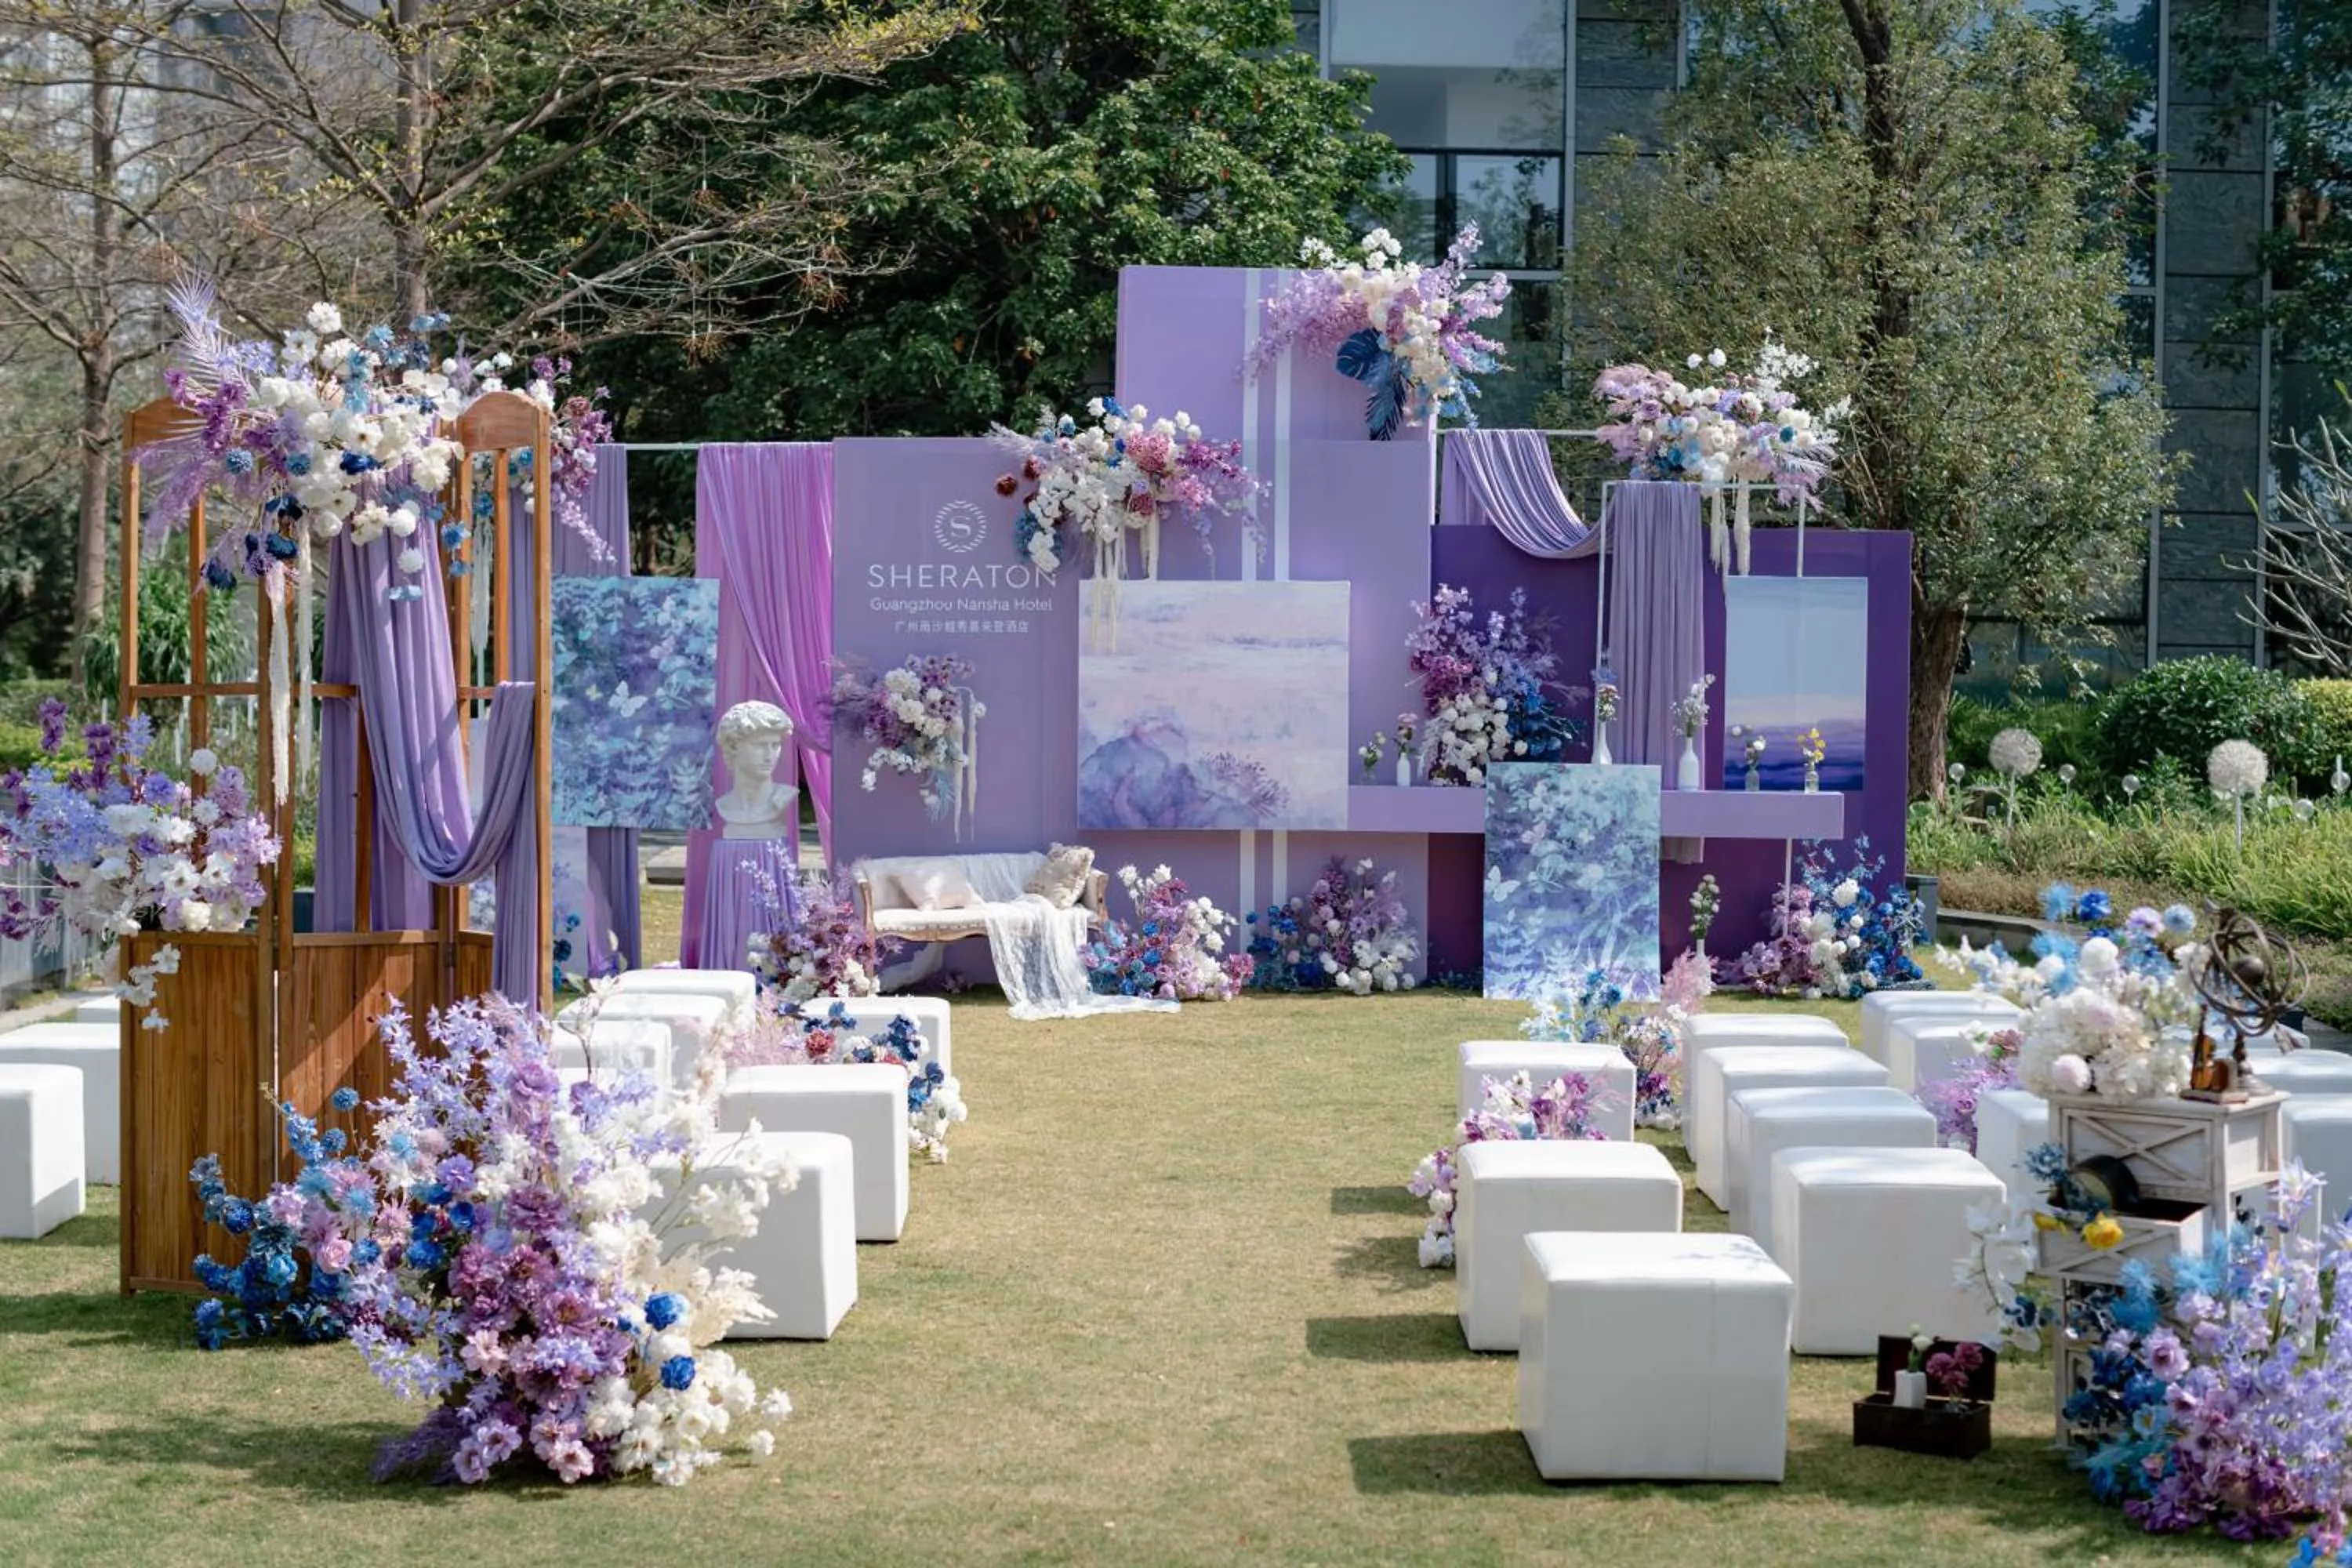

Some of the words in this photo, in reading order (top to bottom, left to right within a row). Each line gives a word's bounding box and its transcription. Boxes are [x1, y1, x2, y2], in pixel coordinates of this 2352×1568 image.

[950, 515, 971, 538] S
[867, 564, 1056, 588] SHERATON
[870, 597, 953, 613] Guangzhou
[957, 598, 1010, 611] Nansha
[1014, 598, 1052, 611] Hotel
